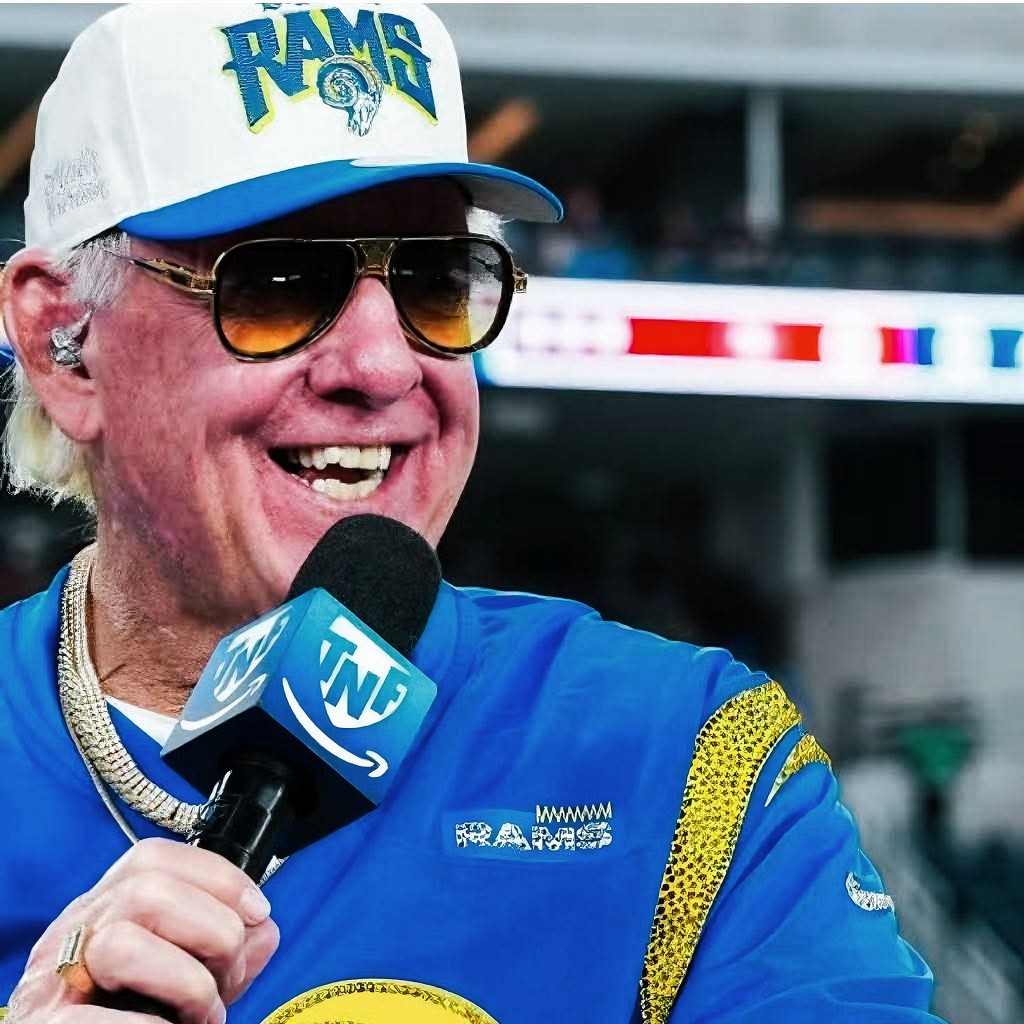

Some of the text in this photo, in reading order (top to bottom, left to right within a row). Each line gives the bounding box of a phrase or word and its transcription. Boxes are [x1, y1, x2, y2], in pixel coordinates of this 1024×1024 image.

[217, 6, 439, 133] RAMS
[319, 621, 411, 726] TNF
[455, 821, 613, 852] RAMS
